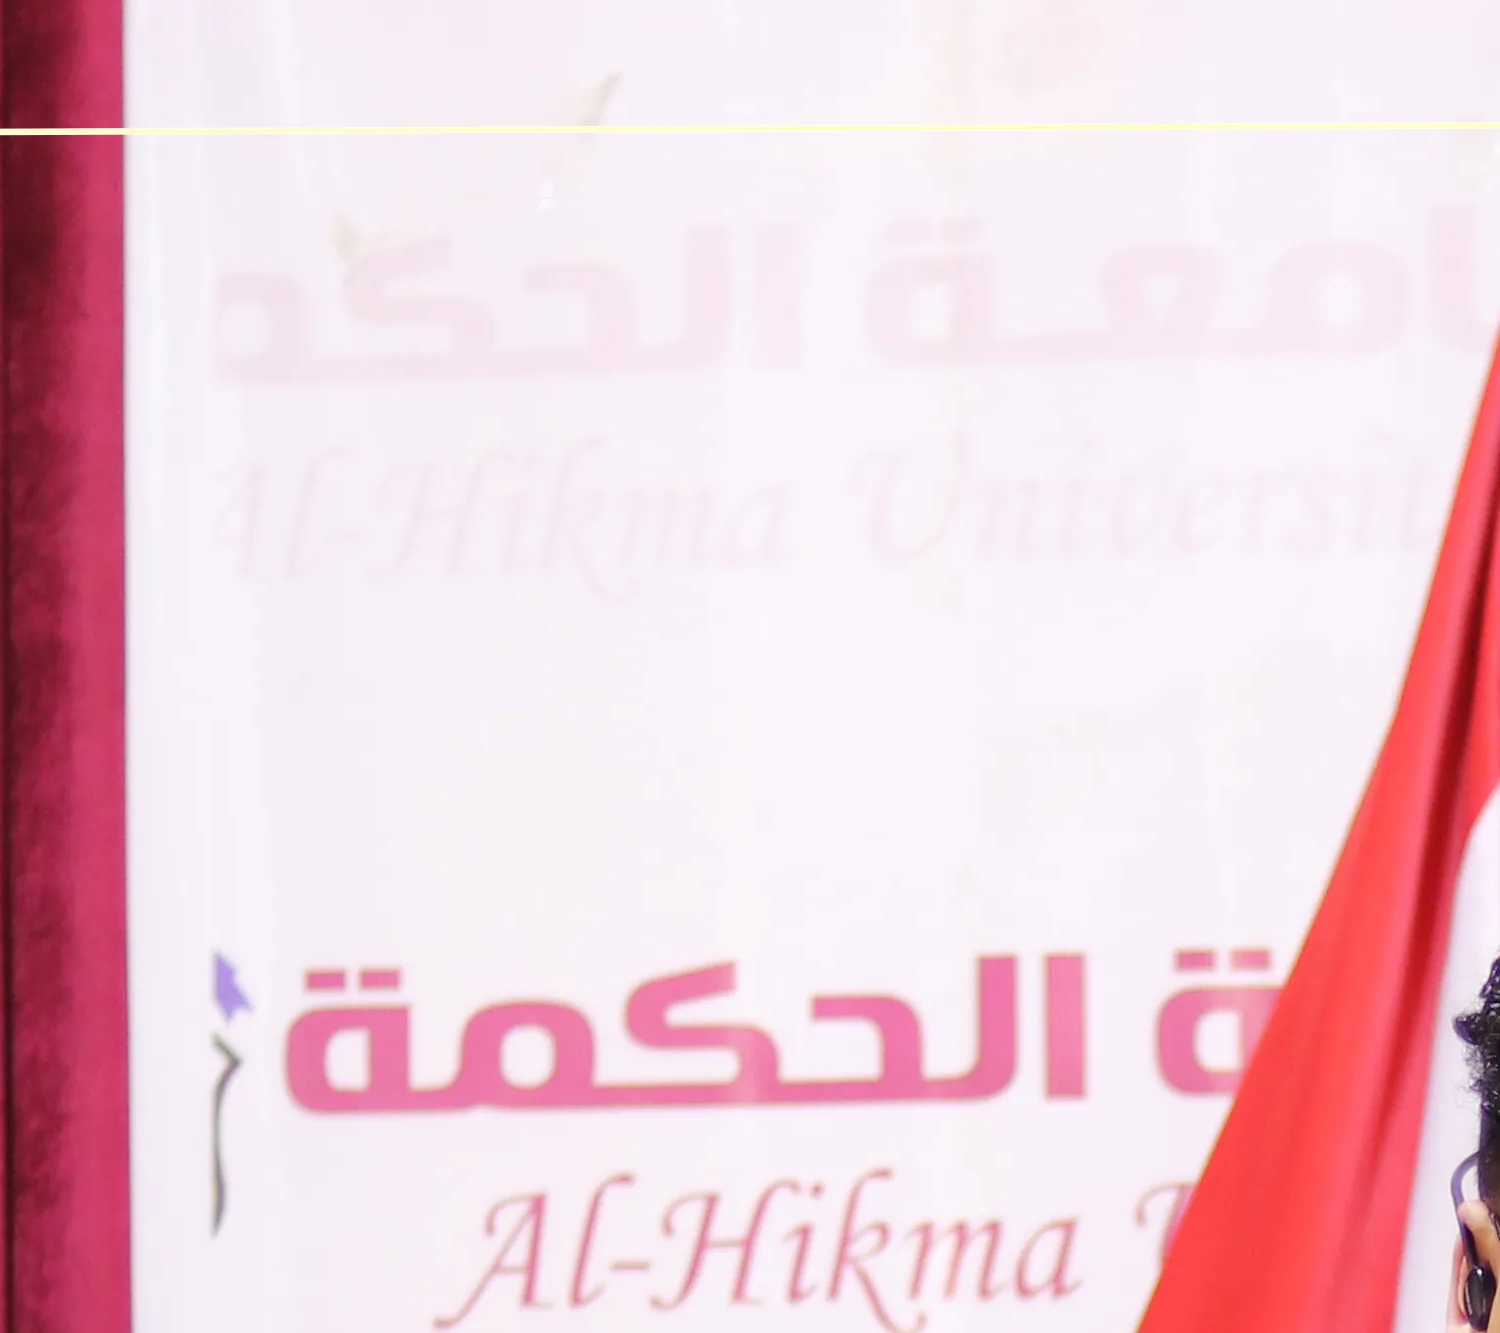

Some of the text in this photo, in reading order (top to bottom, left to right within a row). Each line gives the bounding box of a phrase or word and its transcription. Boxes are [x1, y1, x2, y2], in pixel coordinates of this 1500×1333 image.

[214, 220, 802, 386] الحكم
[847, 429, 1445, 565] Universit
[283, 953, 1088, 1114] الحكمة
